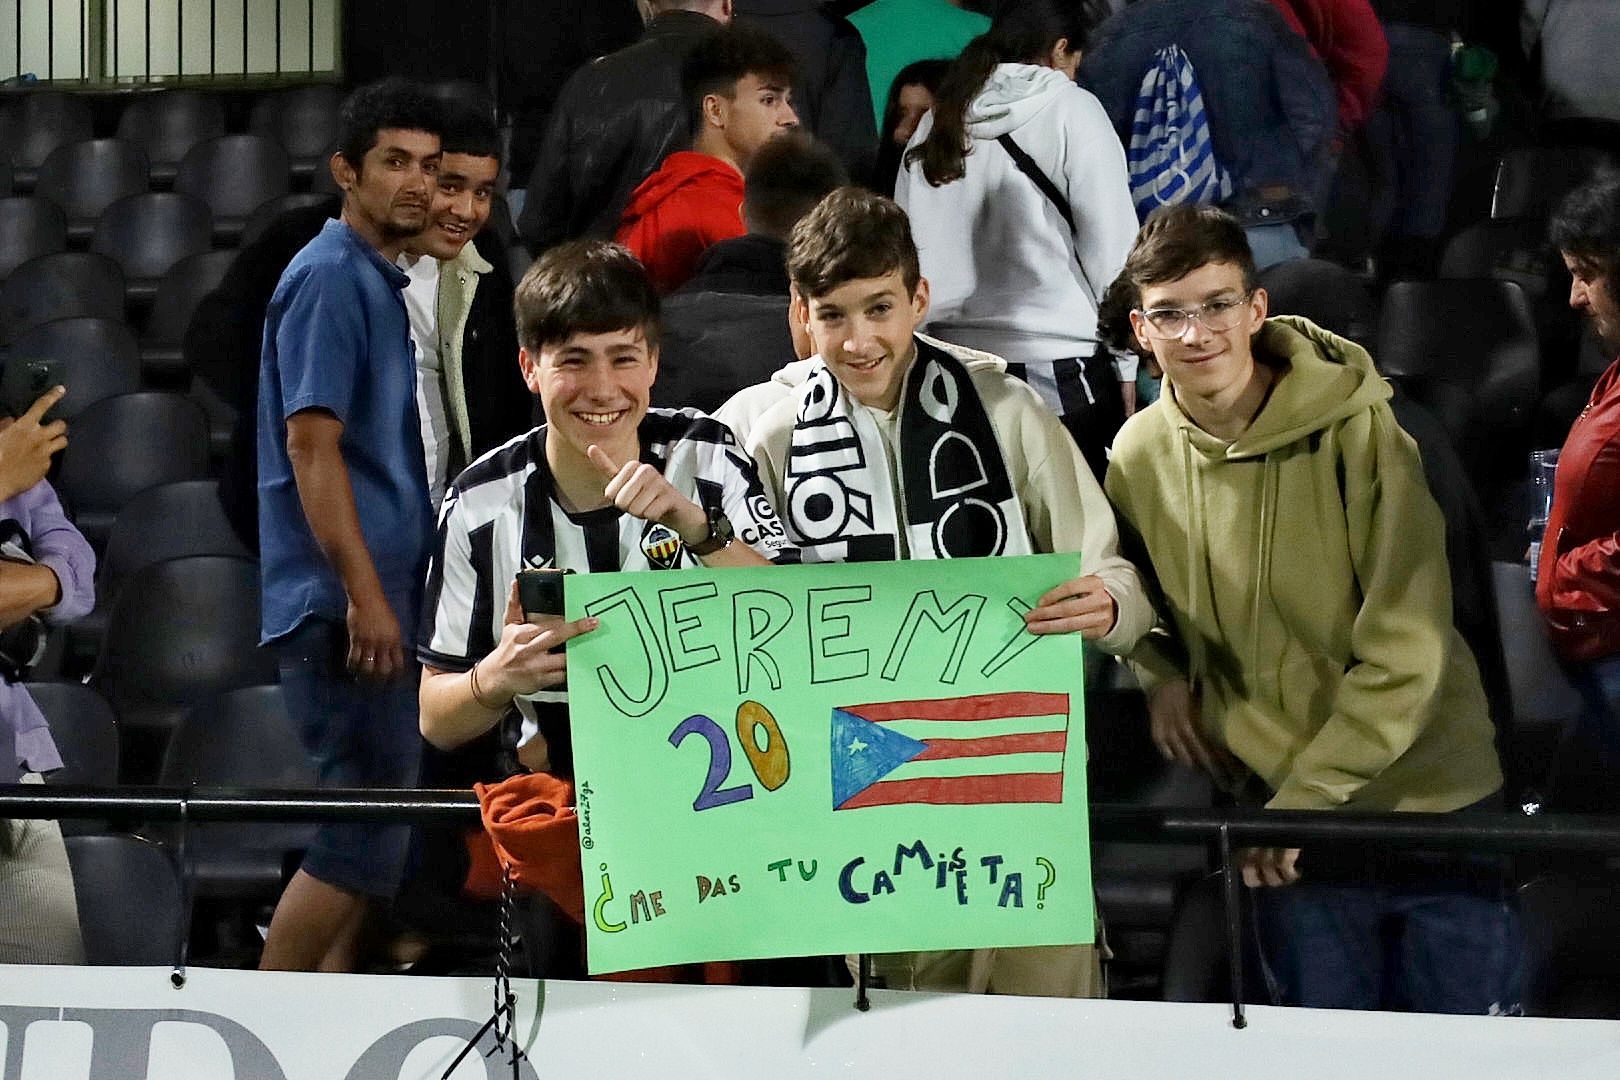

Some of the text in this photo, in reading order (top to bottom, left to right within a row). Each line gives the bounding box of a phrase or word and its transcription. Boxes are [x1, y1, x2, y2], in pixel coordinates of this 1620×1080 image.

[584, 581, 1044, 718] JEREMY
[667, 700, 791, 812] 20
[696, 874, 741, 904] DAS
[767, 858, 818, 882] TU
